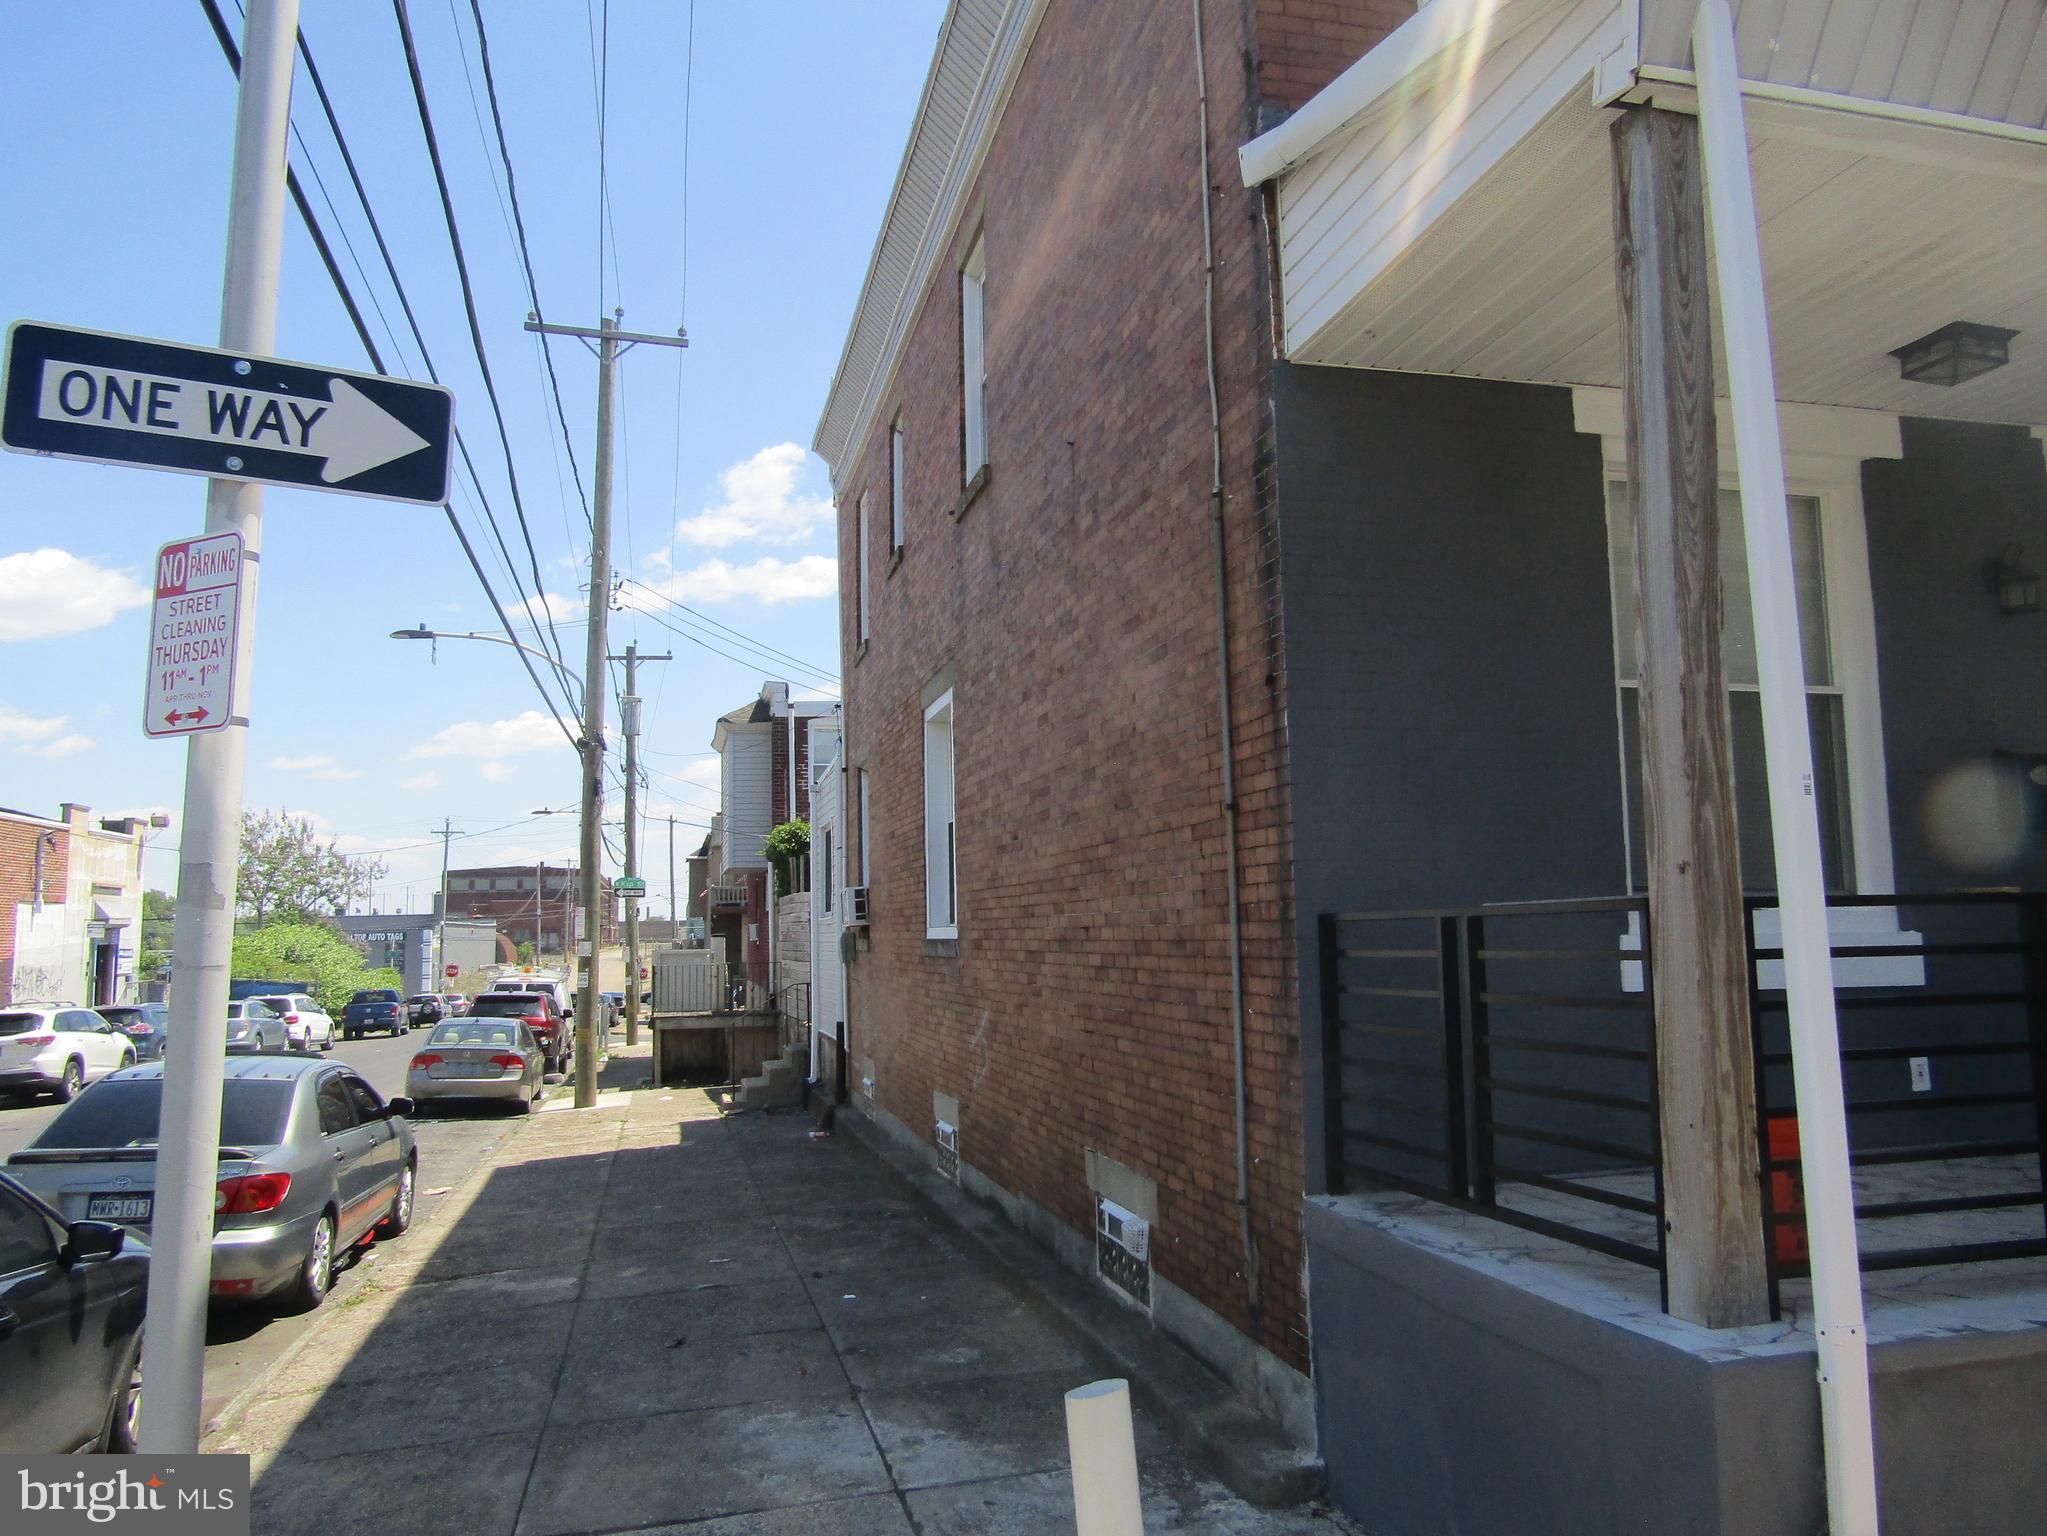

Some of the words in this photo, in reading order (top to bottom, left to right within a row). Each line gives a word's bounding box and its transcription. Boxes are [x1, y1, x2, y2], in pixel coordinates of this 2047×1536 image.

[59, 370, 181, 429] ONE
[208, 390, 327, 447] WAY
[160, 551, 186, 589] NO
[190, 548, 236, 578] PARKING
[169, 593, 221, 617] STREET
[161, 615, 226, 640] CLEANING
[156, 637, 228, 666] THURSDAY
[198, 690, 212, 699] NOV
[368, 933, 386, 941] AUTO
[386, 932, 404, 941] TAGS
